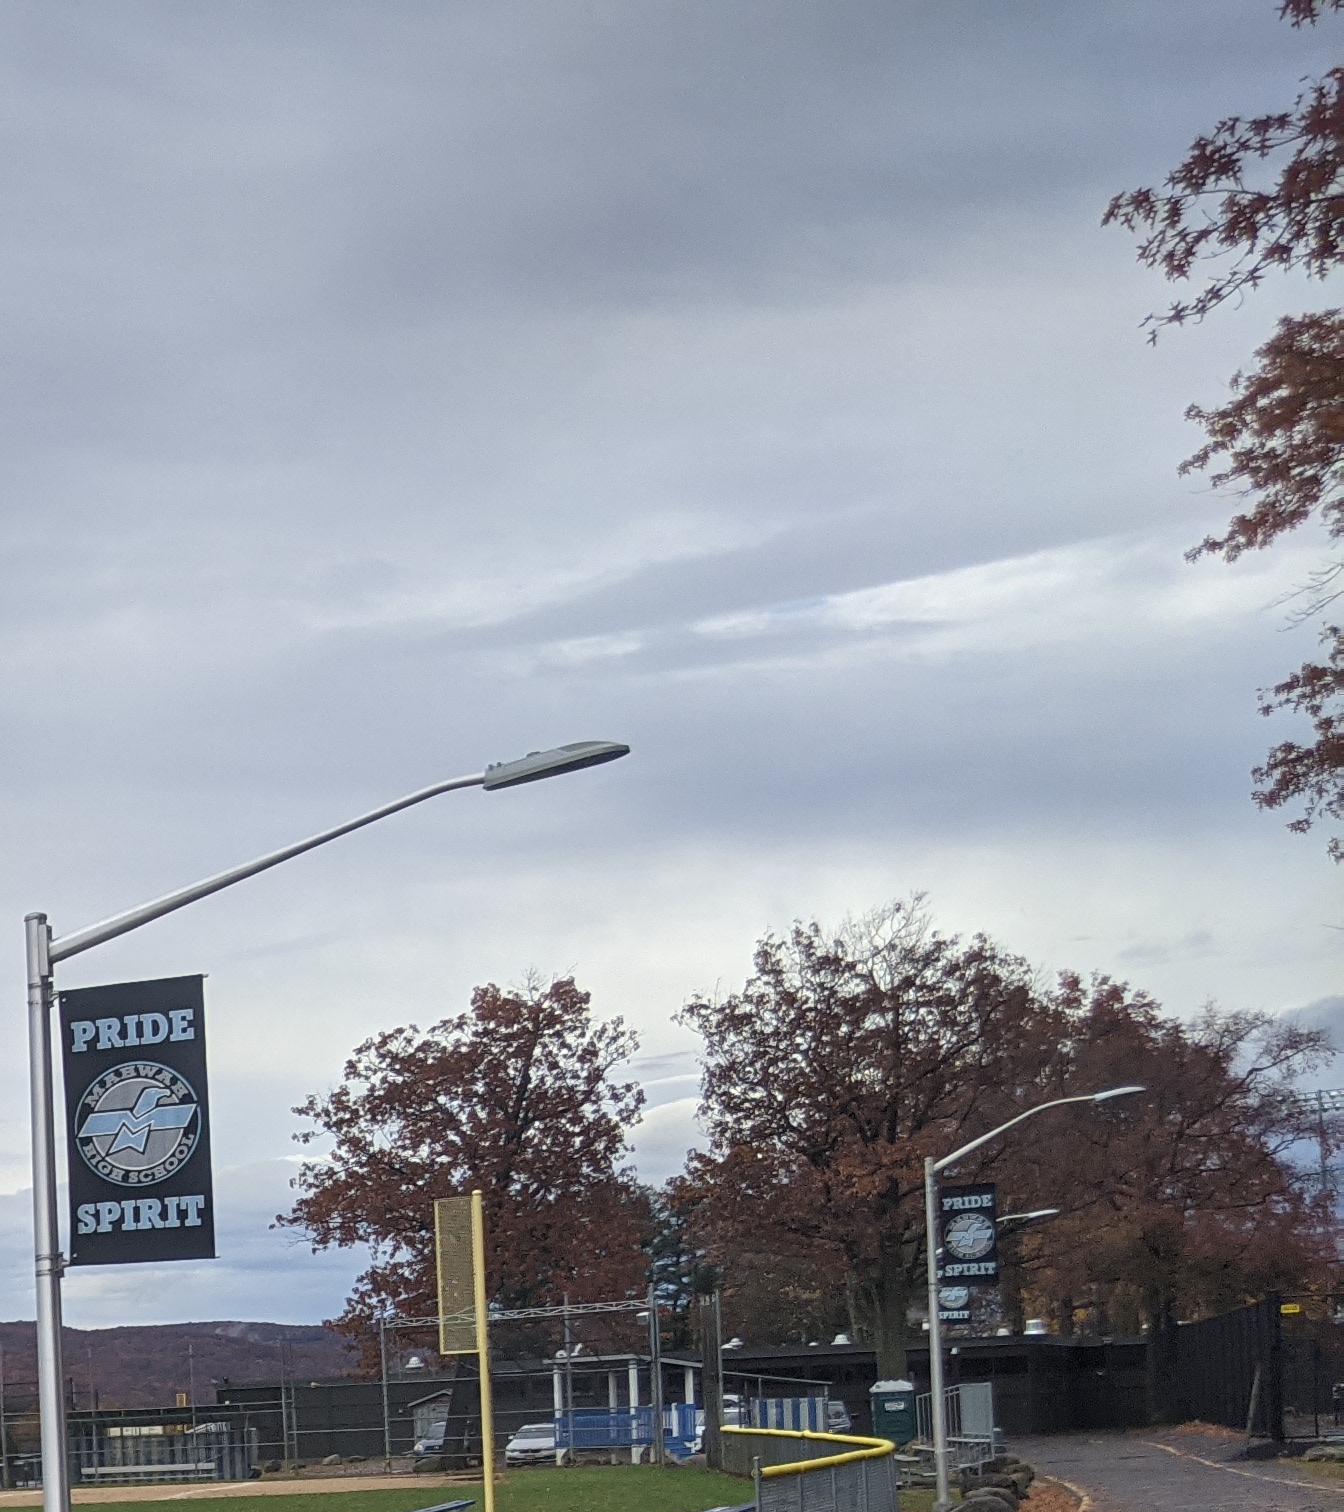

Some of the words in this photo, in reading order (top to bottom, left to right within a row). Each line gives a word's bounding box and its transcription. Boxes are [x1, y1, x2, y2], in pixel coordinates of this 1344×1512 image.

[70, 1008, 195, 1053] PRIDE
[85, 1065, 189, 1107] MAHWAH
[82, 1142, 126, 1182] HIGH
[127, 1134, 196, 1183] SCHOOL
[77, 1195, 205, 1234] SPIRIT
[942, 1195, 992, 1210] PRIDE
[945, 1263, 996, 1276] SPIRIT
